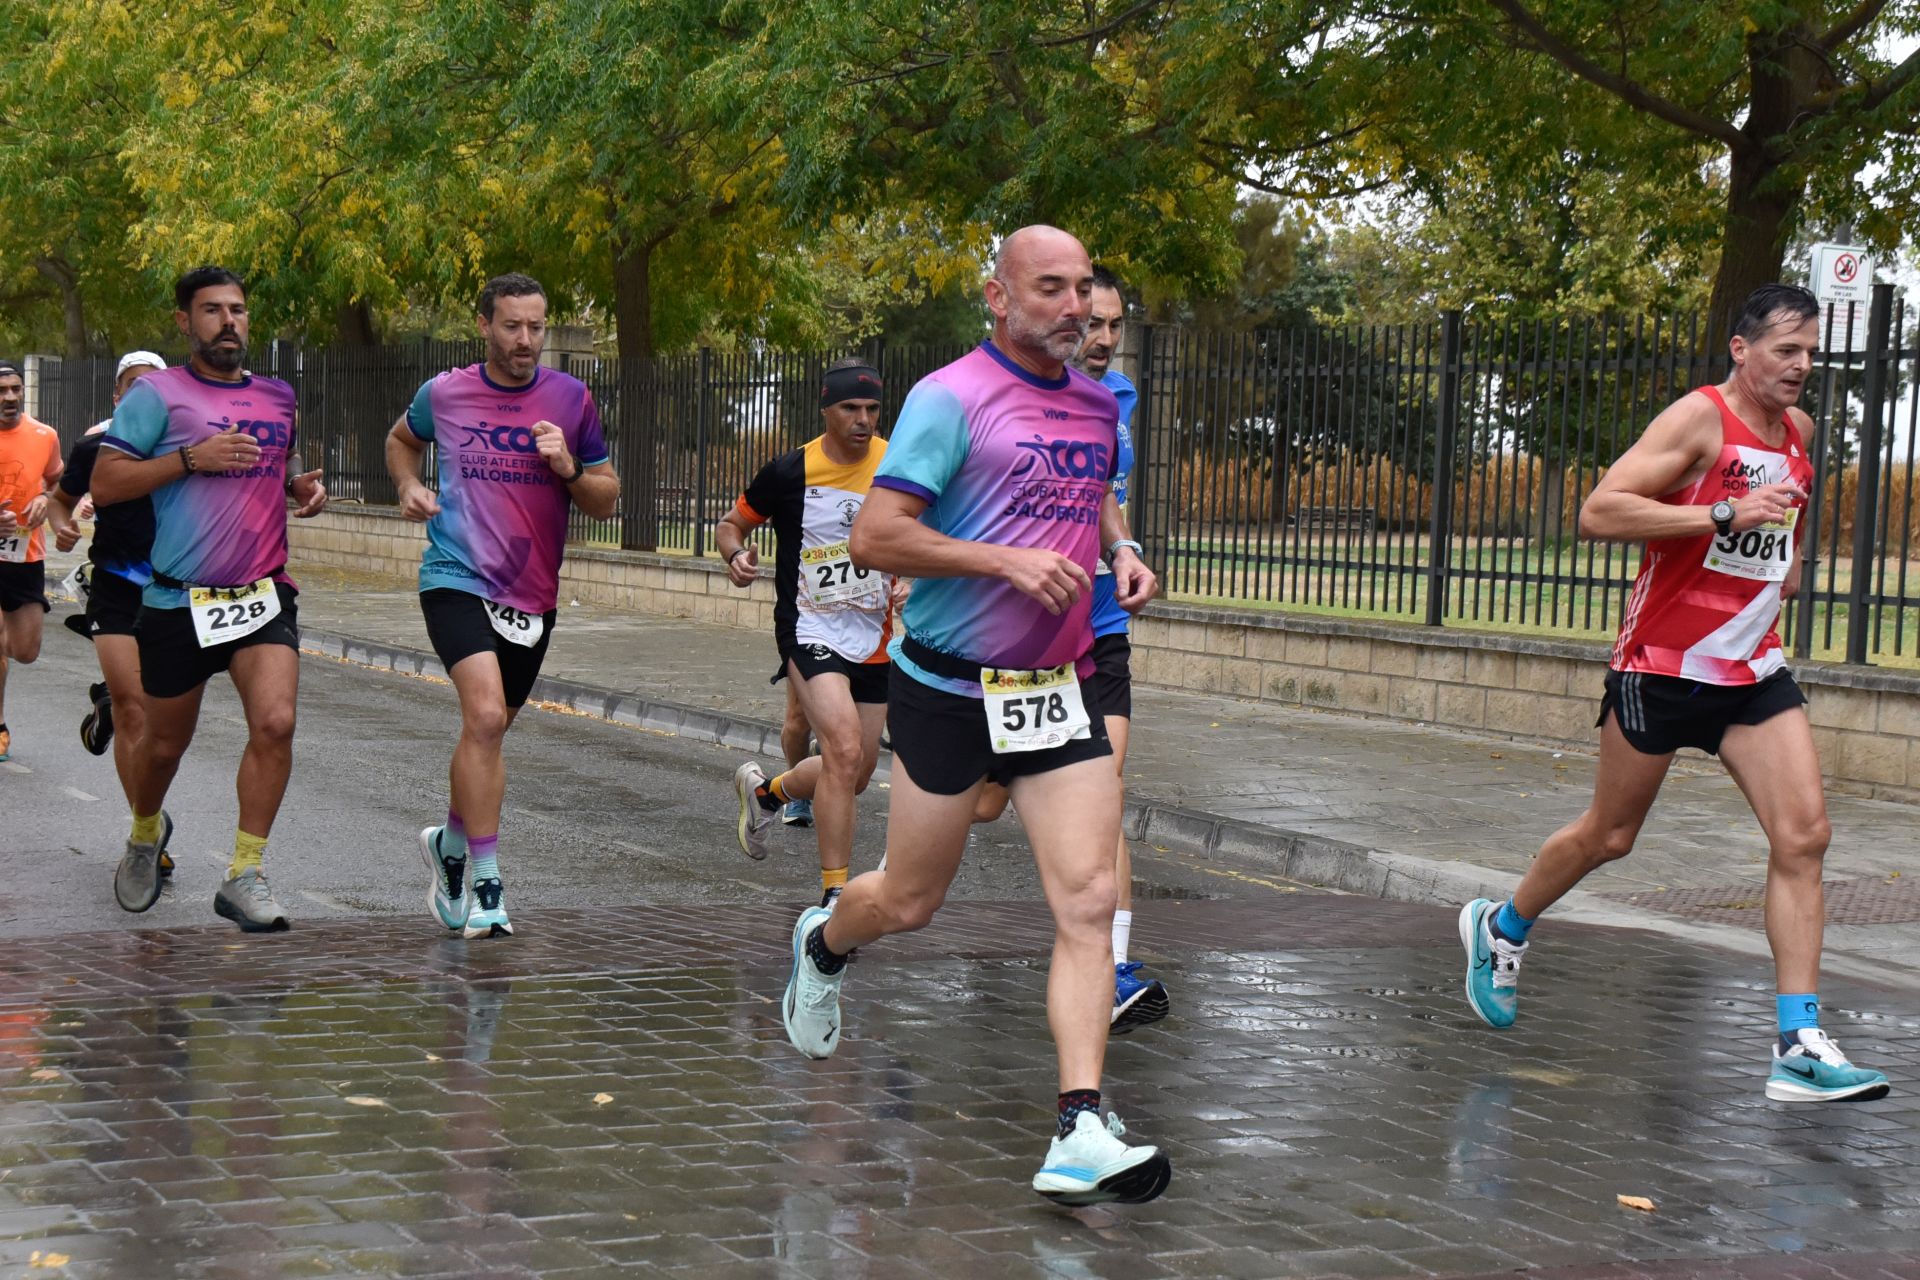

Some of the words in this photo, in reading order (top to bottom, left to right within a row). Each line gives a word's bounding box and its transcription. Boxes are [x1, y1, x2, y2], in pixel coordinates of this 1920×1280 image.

[497, 404, 522, 413] vive
[1043, 408, 1069, 420] vive
[489, 425, 538, 454] ca
[459, 454, 487, 466] CLUB
[1049, 439, 1109, 482] cas
[1011, 485, 1048, 501] CLUB
[812, 549, 824, 560] 38
[1715, 530, 1788, 562] 3081
[207, 600, 267, 631] 228
[1002, 692, 1069, 732] 578
